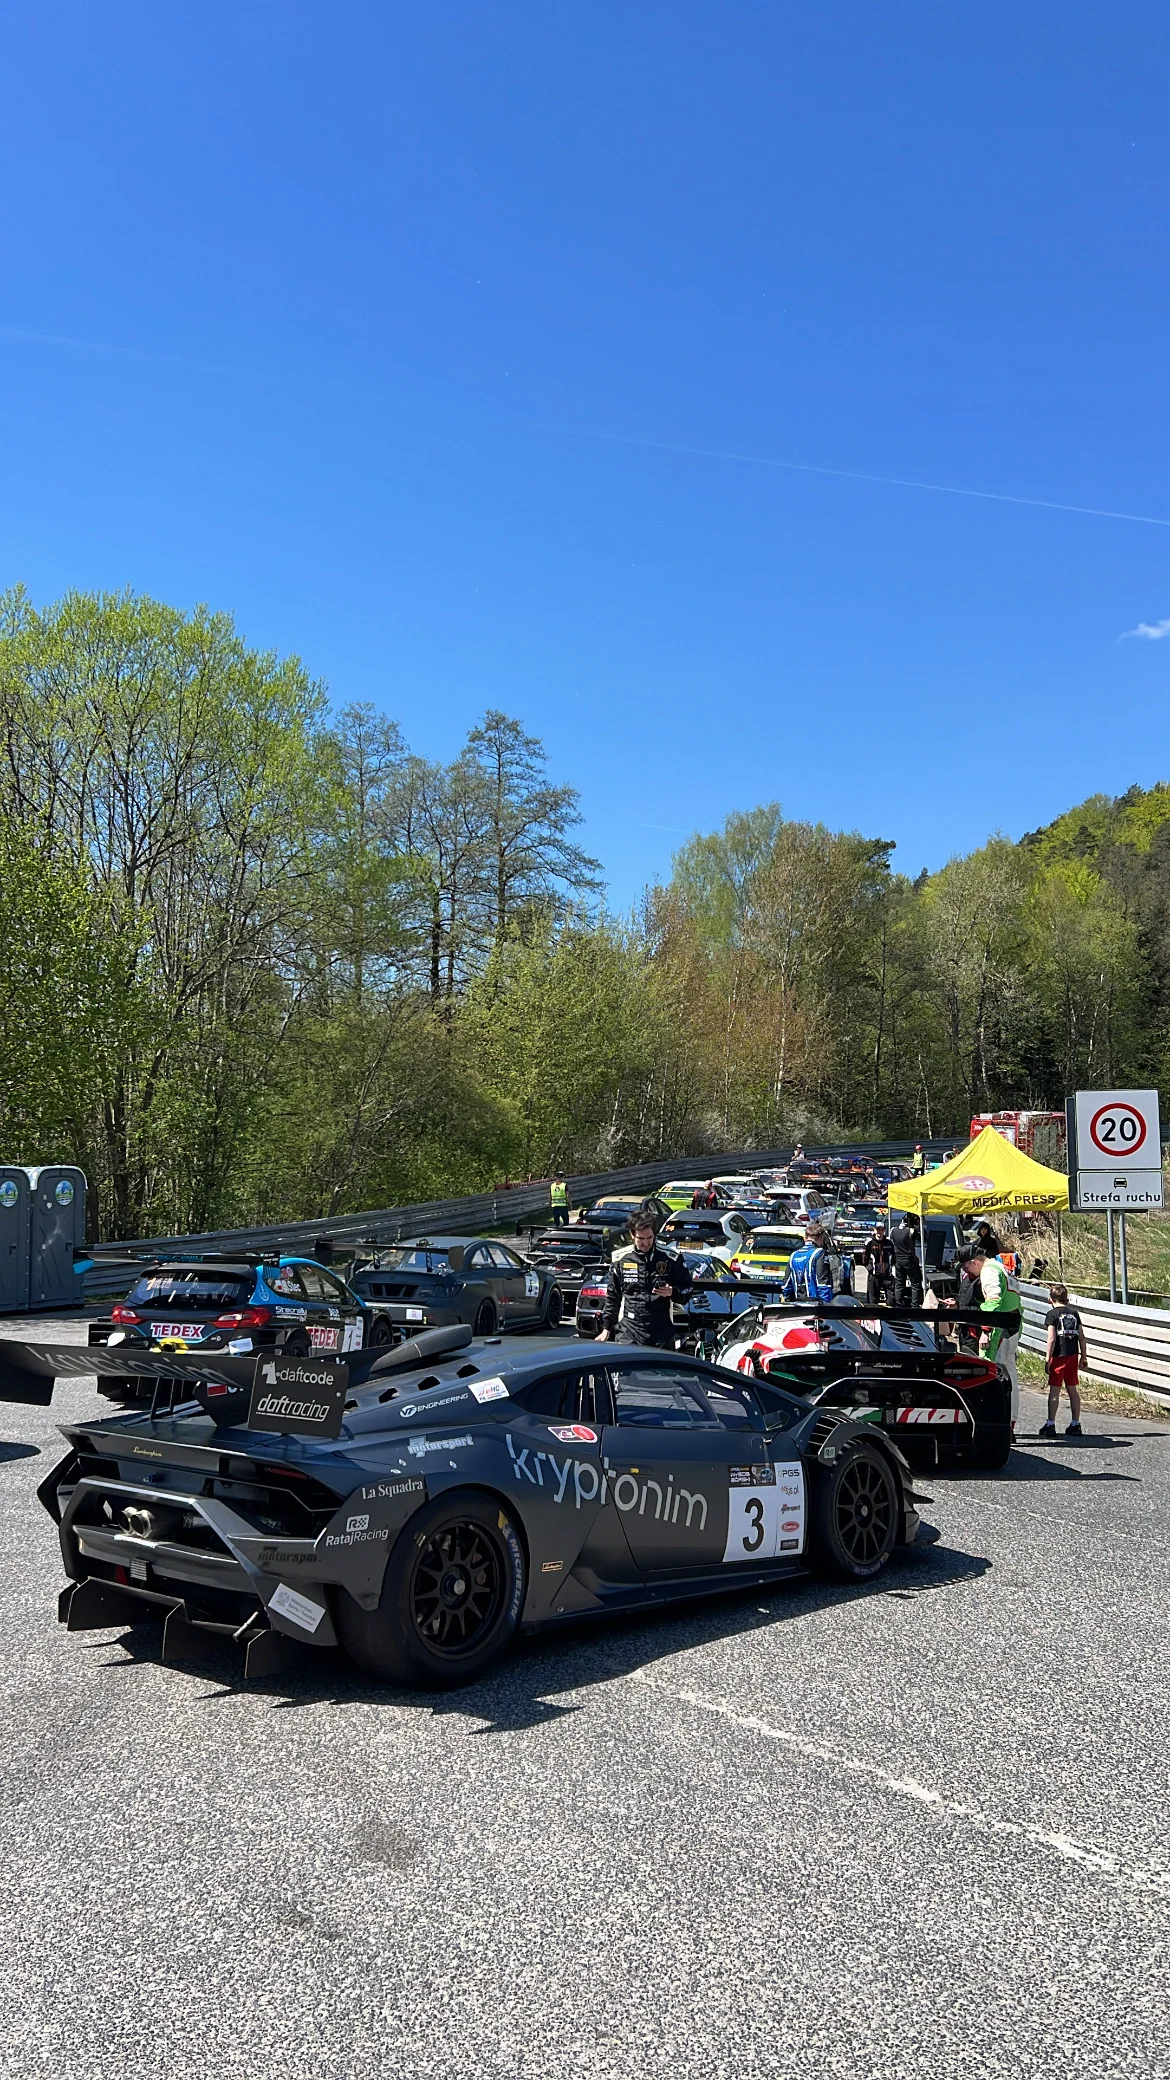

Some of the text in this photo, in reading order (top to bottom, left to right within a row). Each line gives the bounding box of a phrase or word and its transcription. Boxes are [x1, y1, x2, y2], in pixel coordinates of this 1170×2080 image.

[1100, 1117, 1137, 1142] 20
[972, 1194, 1056, 1208] MEDIA PRESS
[1082, 1192, 1161, 1203] Strefa ruchu
[151, 1324, 205, 1338] TEDEX
[307, 1328, 340, 1347] TEDEX
[280, 1367, 334, 1385] daftcode
[257, 1394, 330, 1418] daftracing
[417, 1392, 469, 1411] ENGINEERING
[407, 1434, 474, 1457] motorsport
[506, 1434, 708, 1530] kryptonim
[782, 1469, 800, 1477] PGS
[362, 1479, 423, 1499] La Squadra
[743, 1498, 764, 1552] 3
[325, 1529, 389, 1547] RatajRacing
[509, 1538, 523, 1620] MICHELIN
